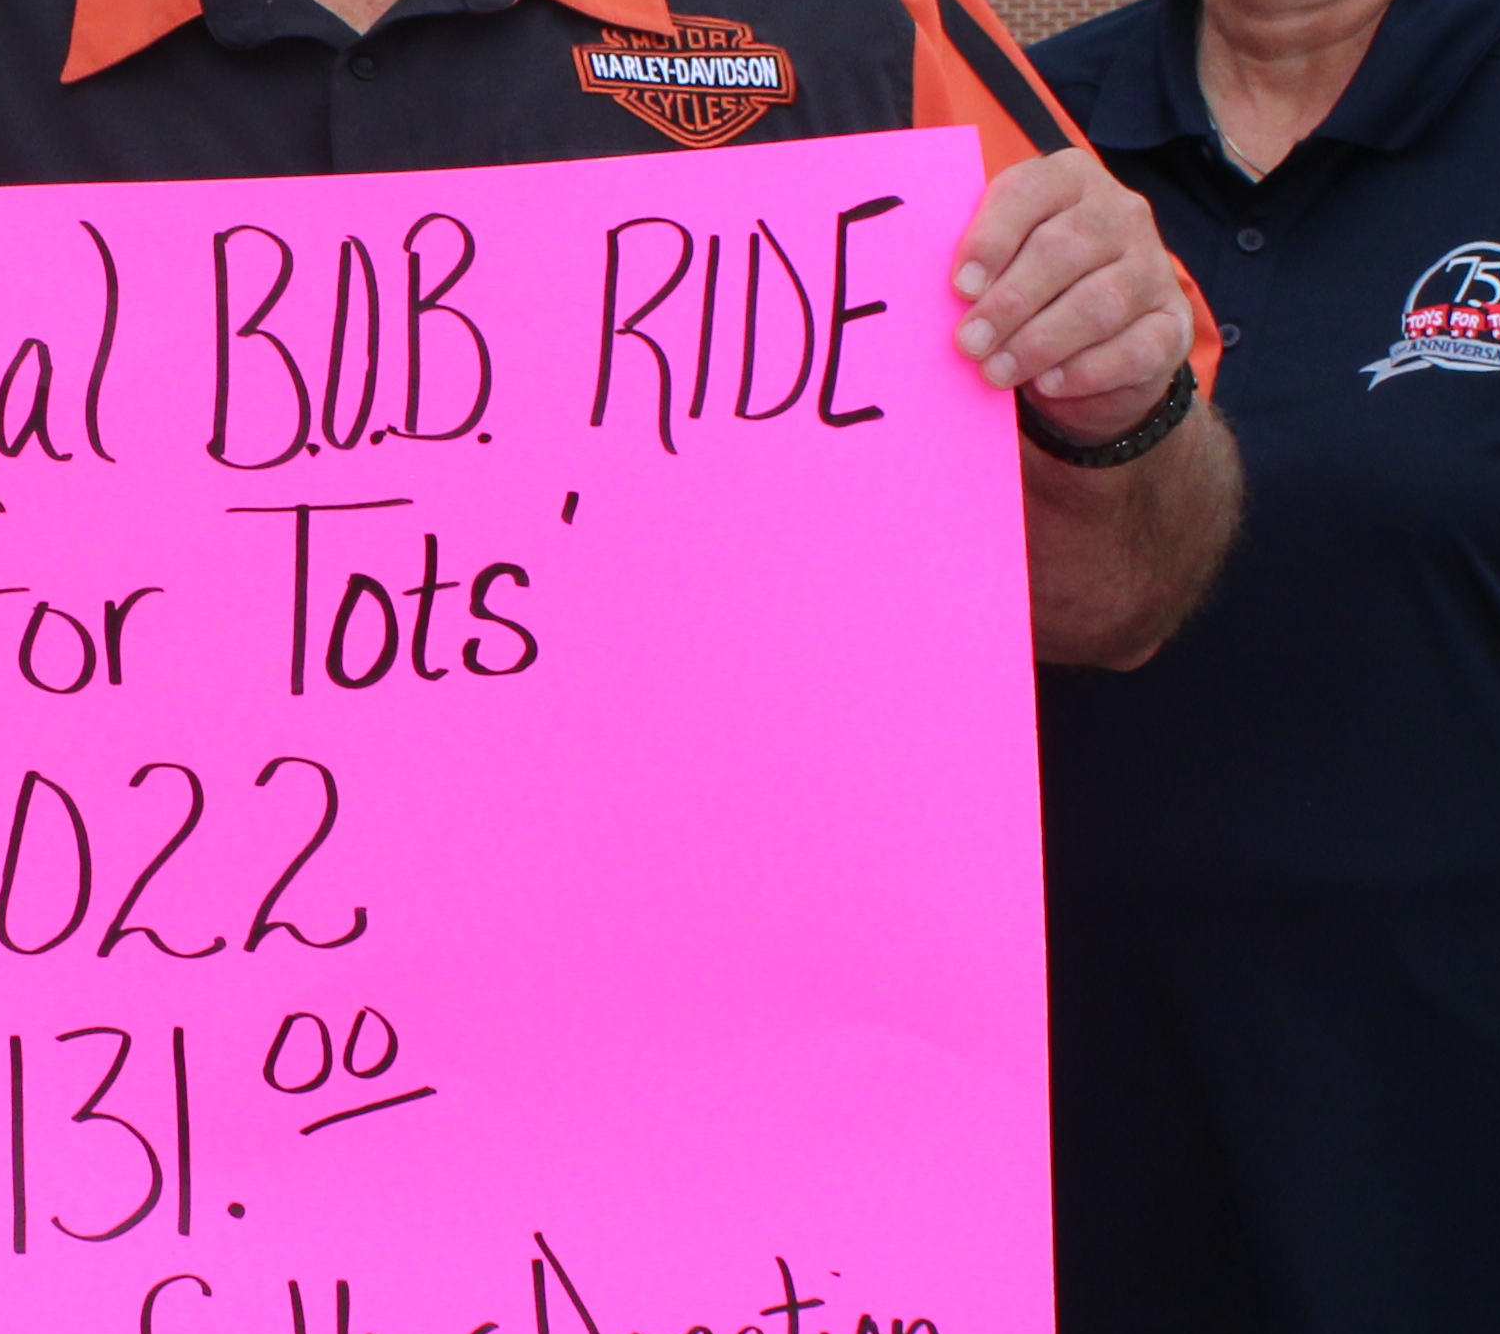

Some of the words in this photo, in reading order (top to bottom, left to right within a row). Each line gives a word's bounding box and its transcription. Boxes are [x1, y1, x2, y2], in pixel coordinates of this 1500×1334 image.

[629, 25, 729, 51] MOTOR
[590, 52, 780, 89] HARLEY-DAVIDSON
[643, 91, 736, 131] CYCLES
[592, 196, 904, 453] RIDE
[1405, 309, 1444, 332] TOYS
[1449, 310, 1481, 330] FOR
